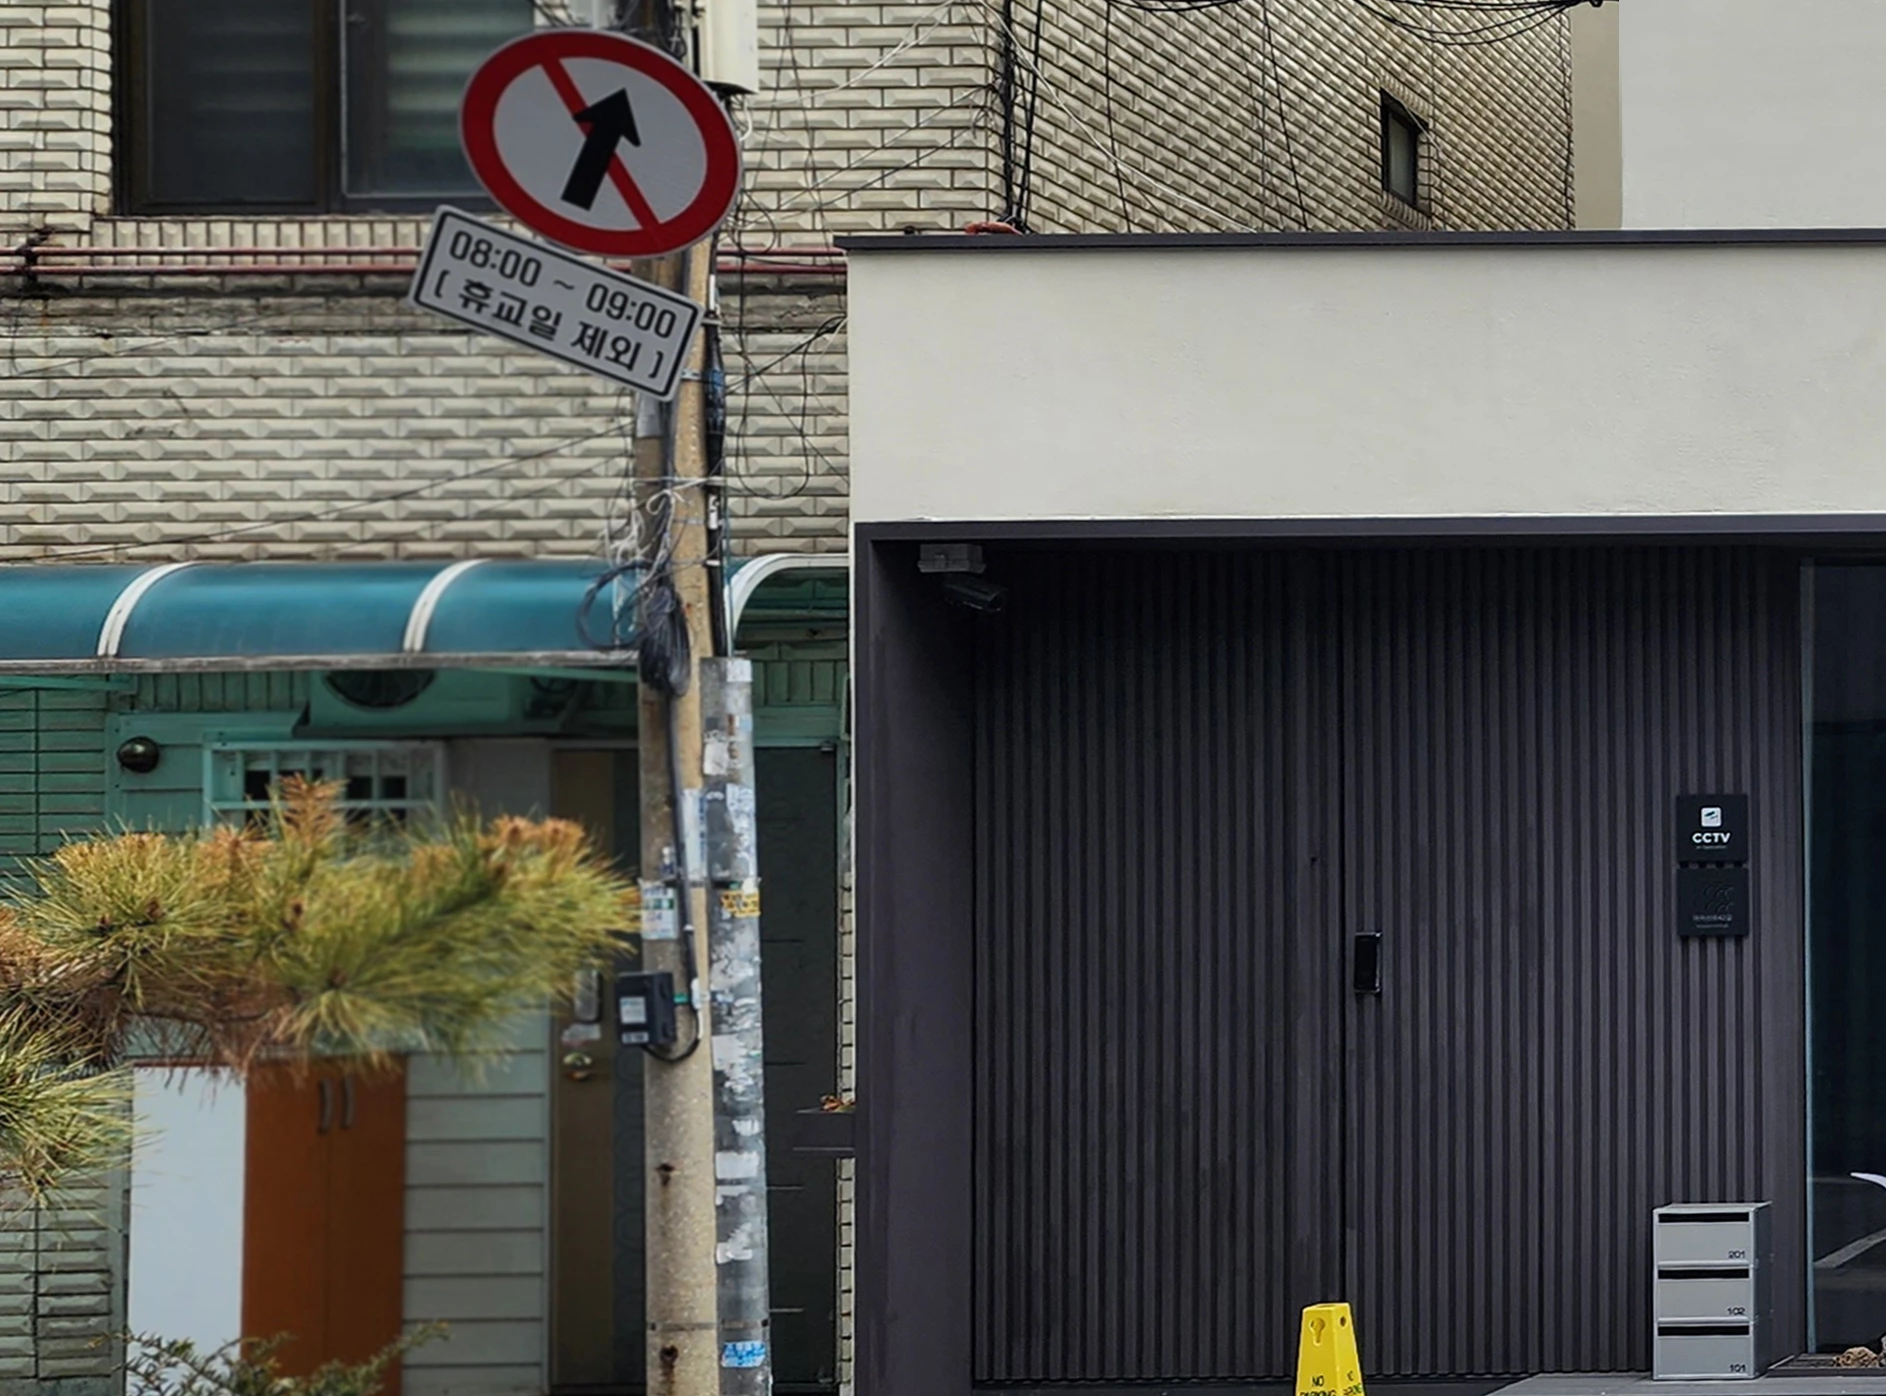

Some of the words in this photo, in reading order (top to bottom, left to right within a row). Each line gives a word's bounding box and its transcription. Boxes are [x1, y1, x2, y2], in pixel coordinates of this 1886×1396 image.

[449, 230, 542, 287] 08:00
[586, 283, 677, 339] 09:00
[458, 278, 563, 342] 휴교일
[571, 320, 642, 372] 제외
[1692, 832, 1731, 844] CCTV
[1728, 1250, 1746, 1259] 201
[1727, 1307, 1746, 1316] 102
[1729, 1364, 1746, 1373] 101
[1312, 1375, 1325, 1387] NO
